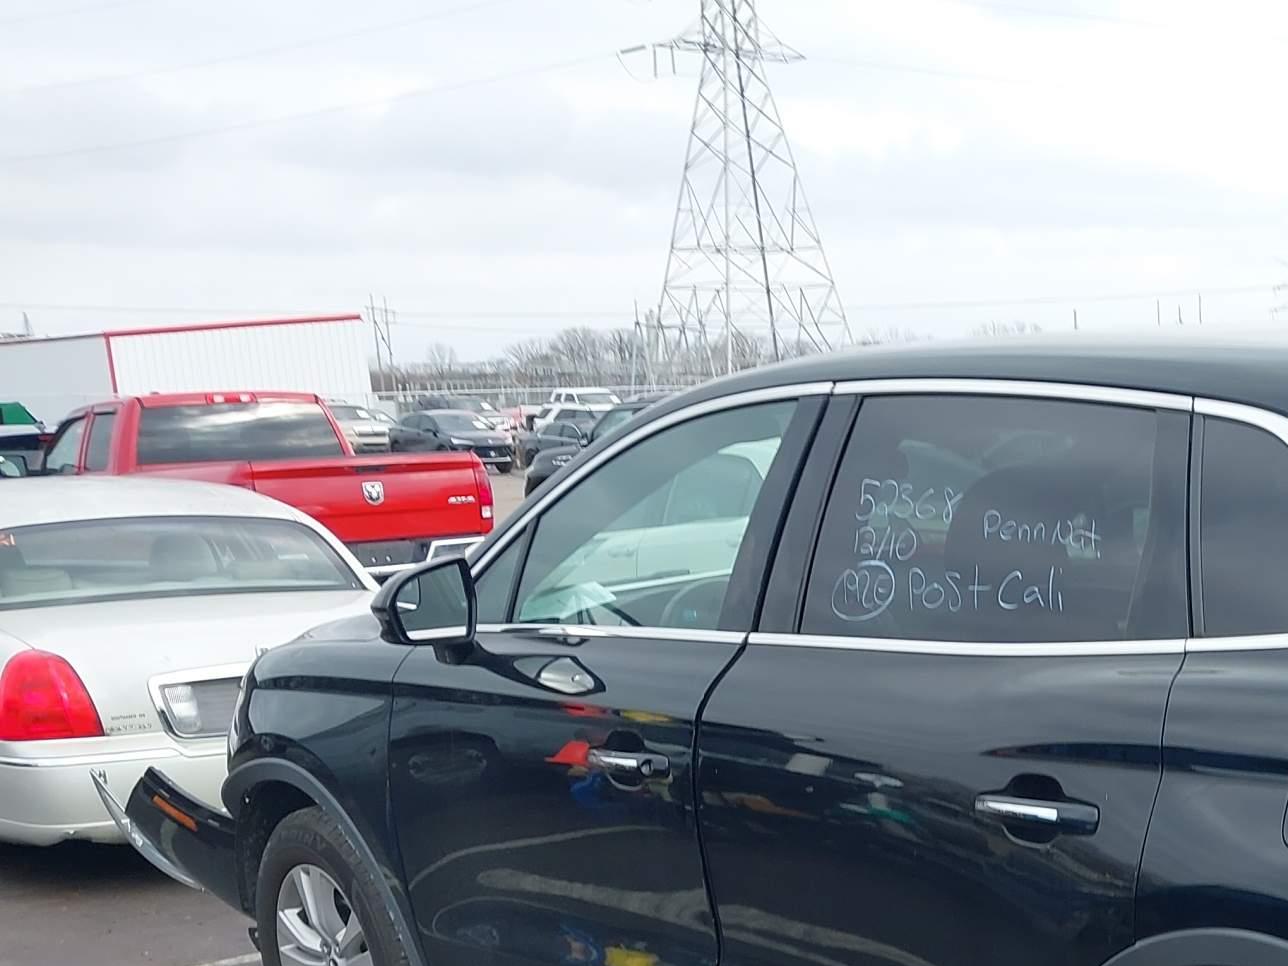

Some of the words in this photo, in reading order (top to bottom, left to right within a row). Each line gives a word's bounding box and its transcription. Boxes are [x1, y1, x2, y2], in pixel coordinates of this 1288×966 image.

[853, 525, 918, 561] 12/10
[983, 508, 1046, 544] Penn
[908, 564, 993, 612] Post
